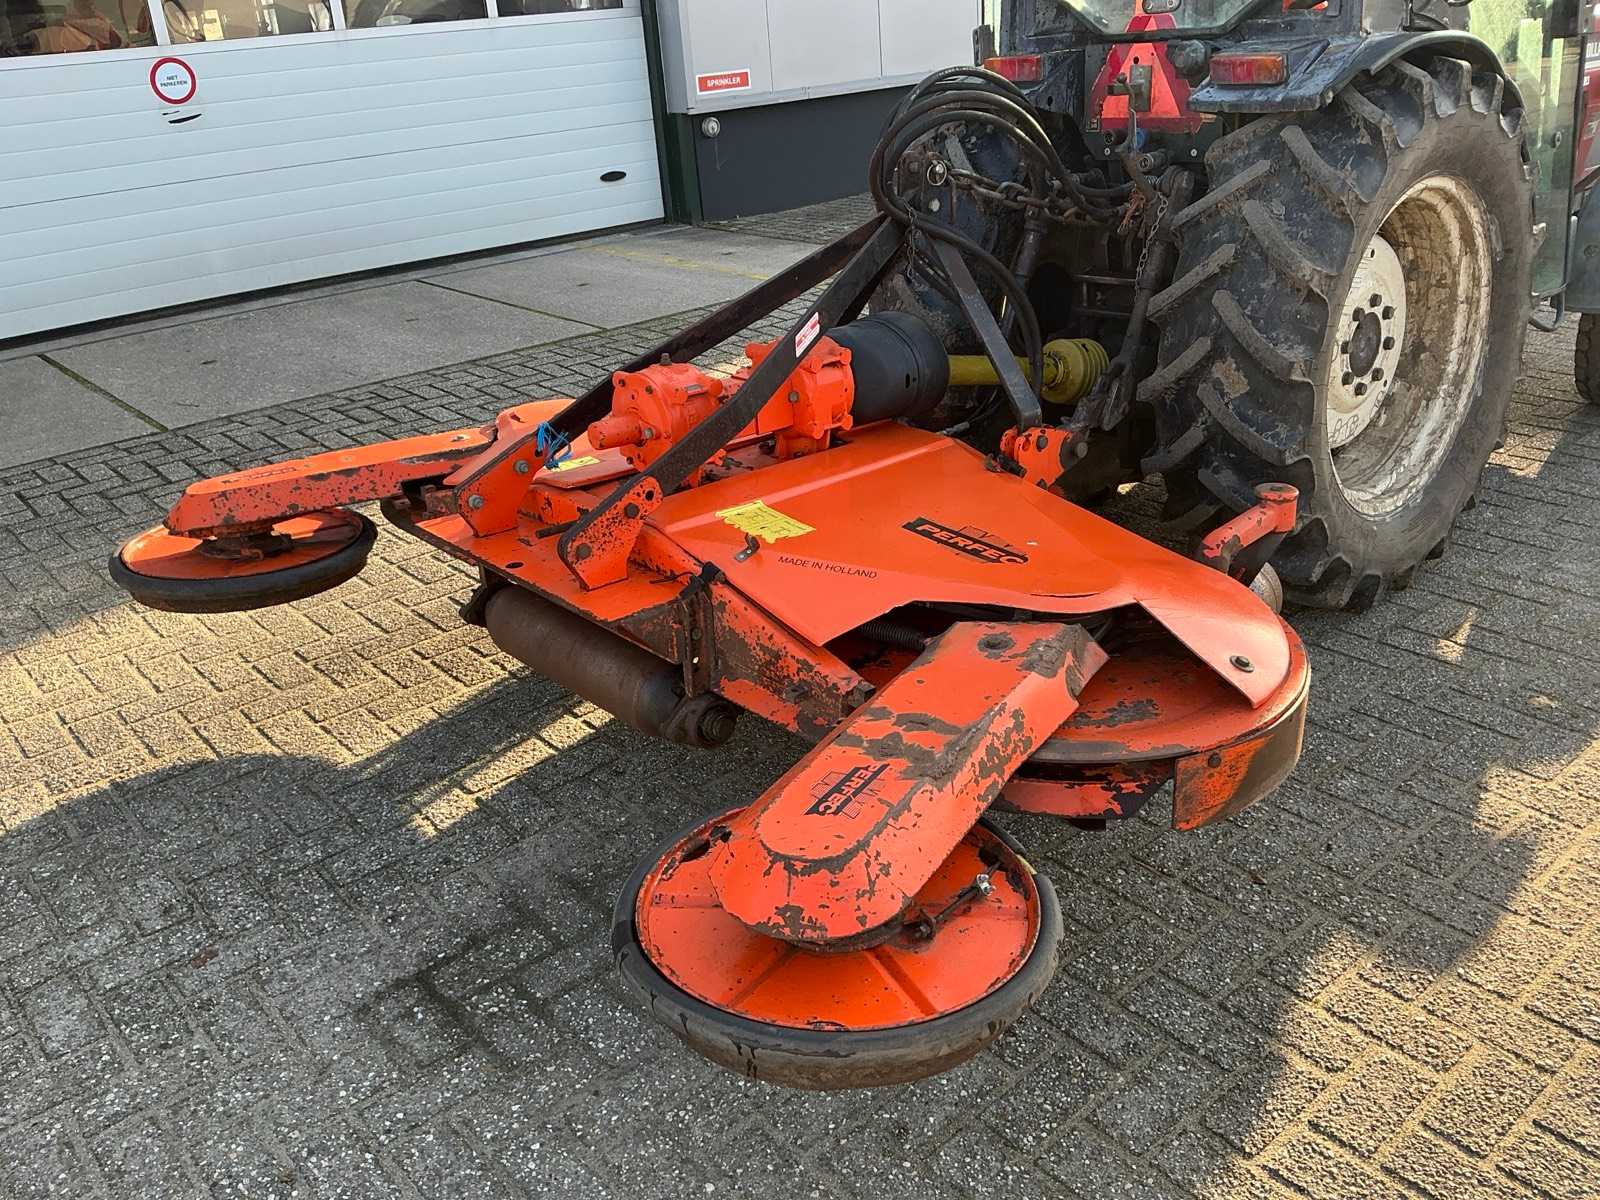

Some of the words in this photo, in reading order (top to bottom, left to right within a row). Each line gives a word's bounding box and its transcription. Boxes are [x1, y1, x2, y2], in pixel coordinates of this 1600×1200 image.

[706, 76, 741, 88] SPRINKLER
[778, 556, 809, 568] MADE
[811, 561, 823, 570] IN
[825, 563, 878, 579] HOLLAND
